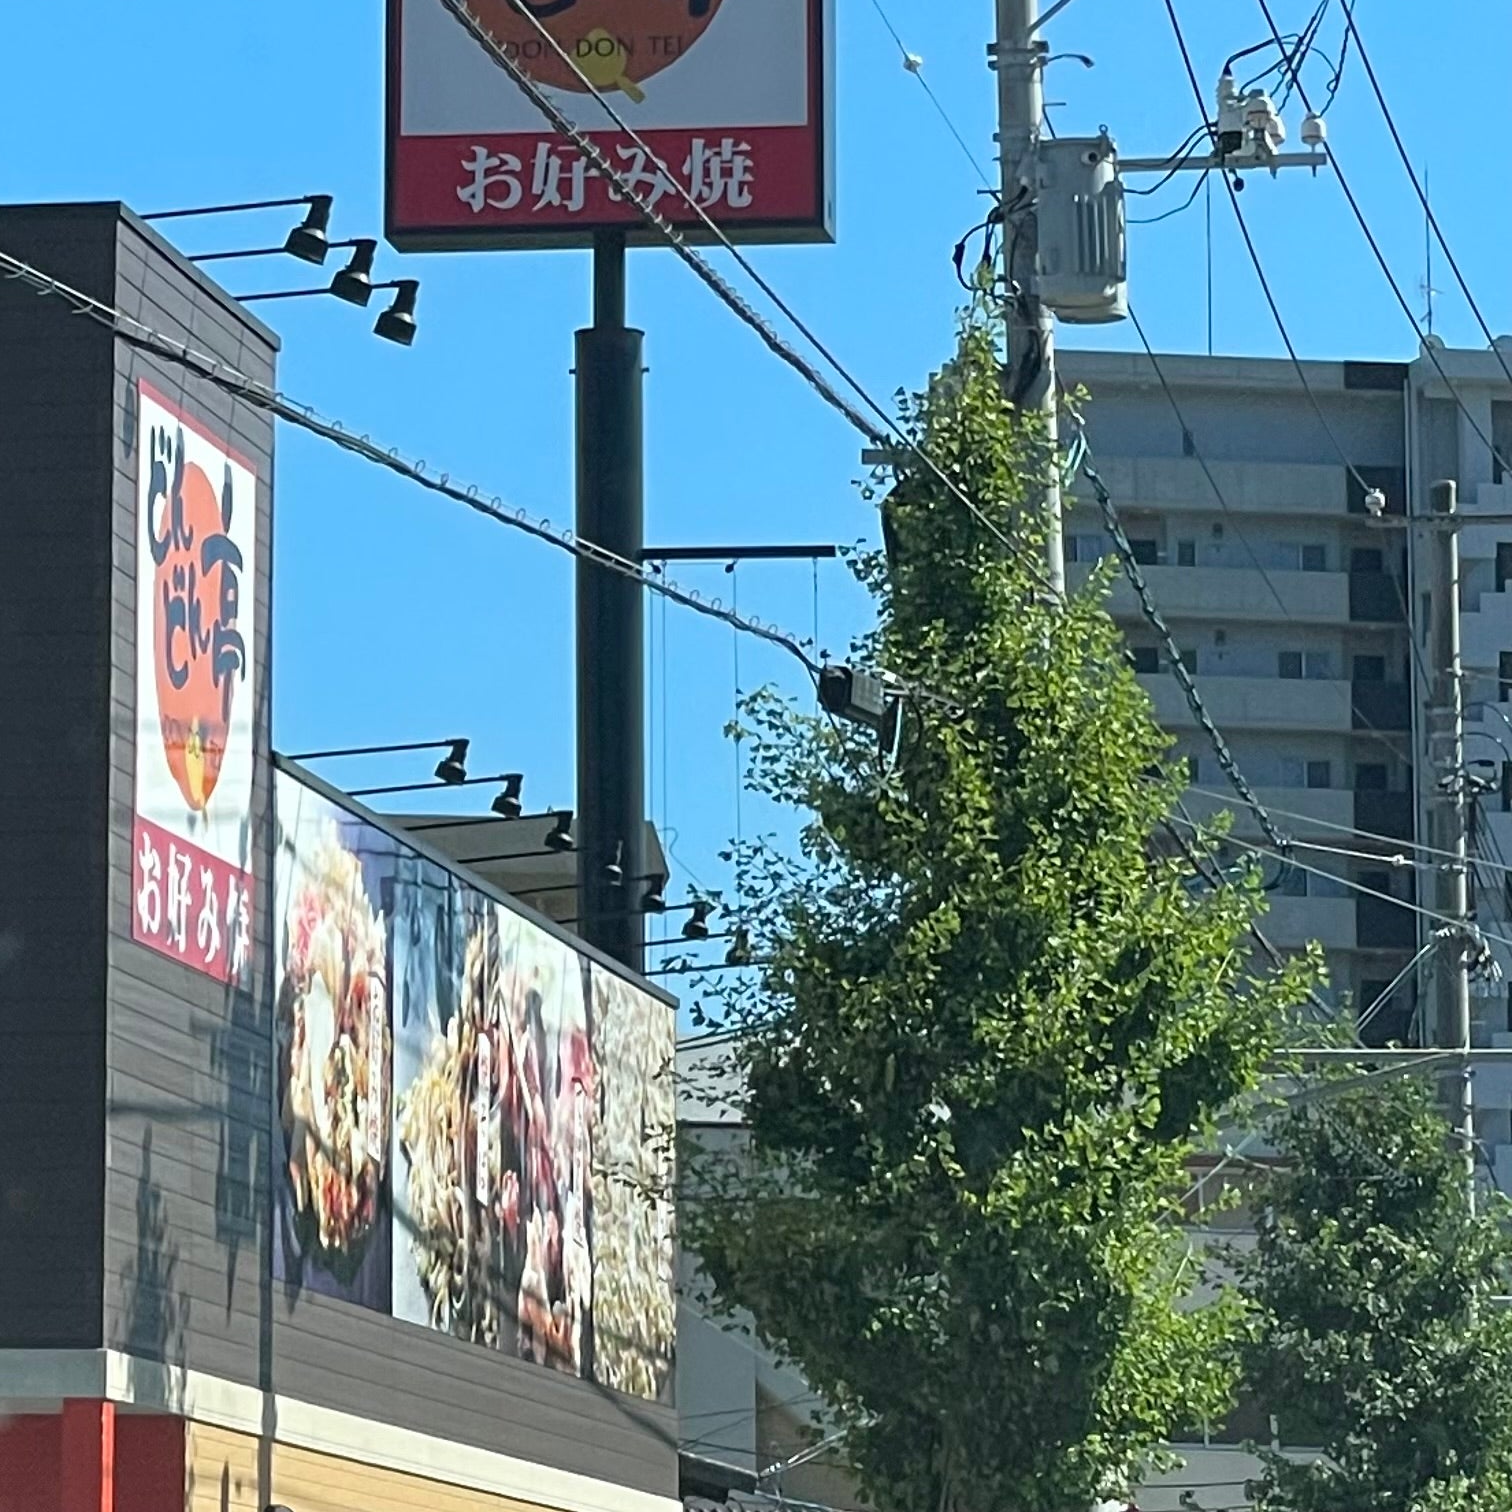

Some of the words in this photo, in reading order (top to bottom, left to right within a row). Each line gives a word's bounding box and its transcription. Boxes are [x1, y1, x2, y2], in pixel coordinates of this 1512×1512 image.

[576, 37, 633, 58] DON
[648, 35, 682, 56] TEI
[456, 138, 755, 213] お好み焼
